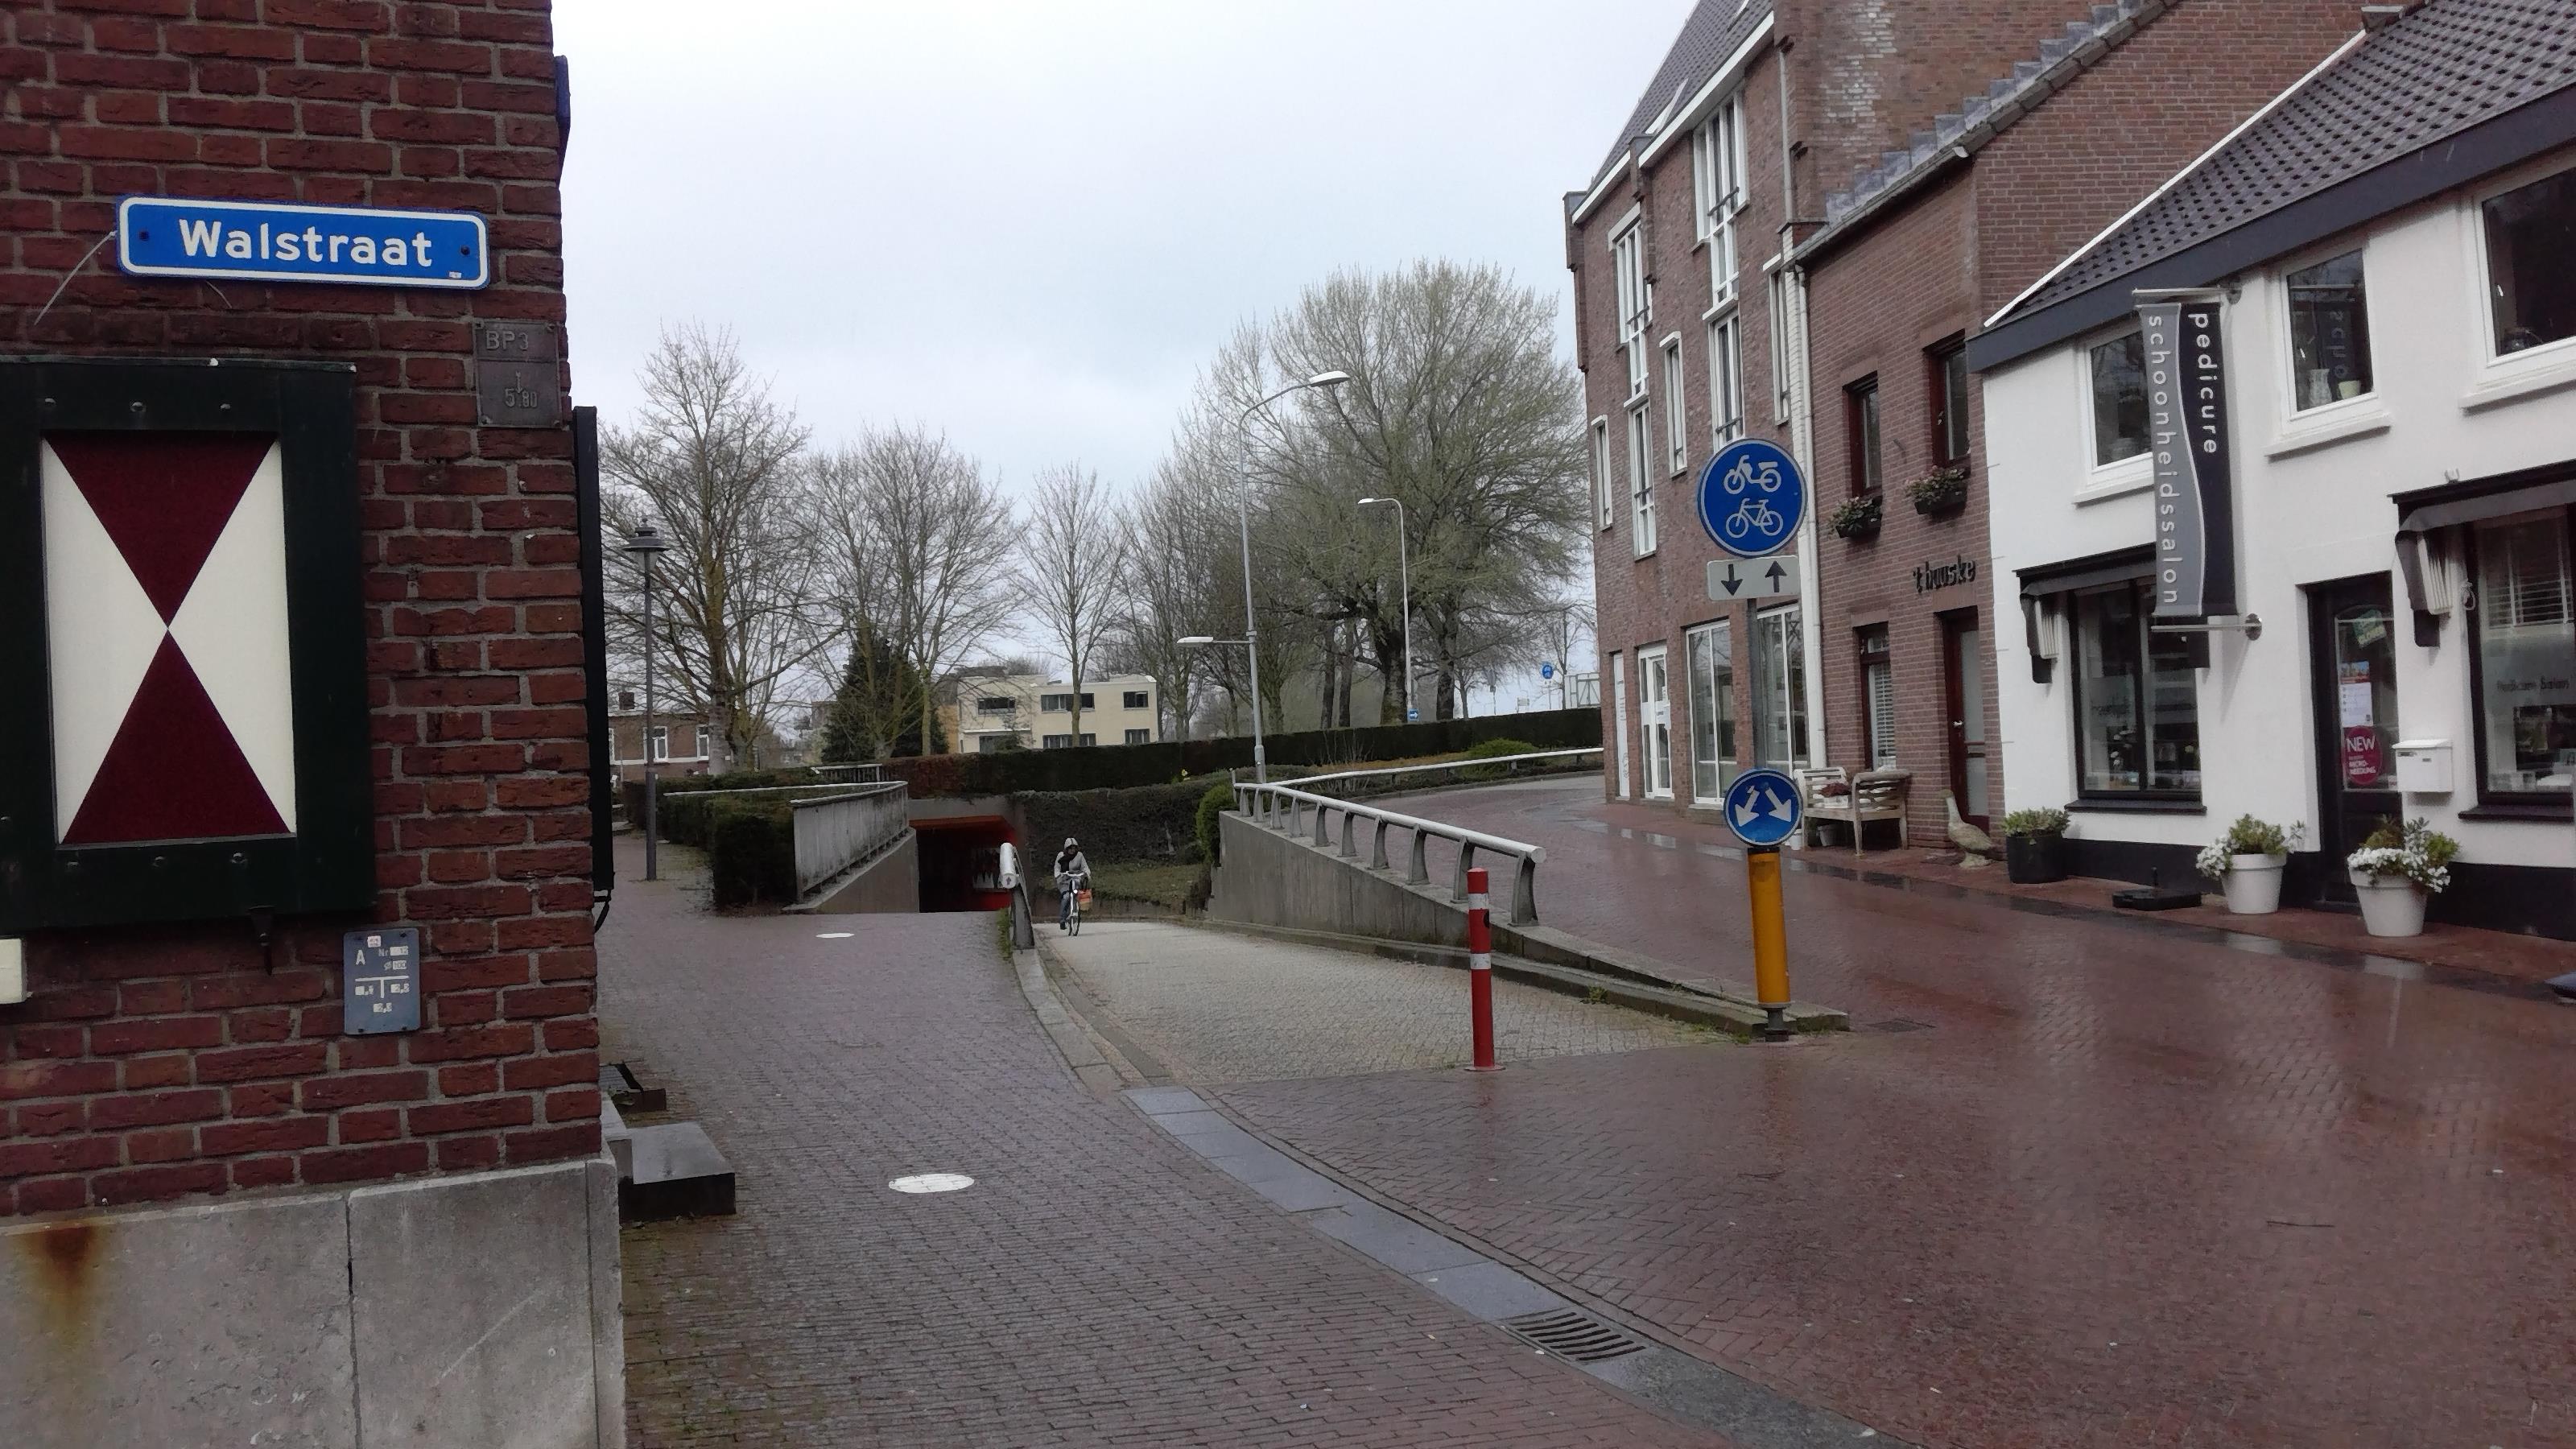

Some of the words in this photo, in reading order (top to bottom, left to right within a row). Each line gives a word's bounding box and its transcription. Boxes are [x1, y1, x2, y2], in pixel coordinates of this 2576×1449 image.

[179, 218, 432, 267] Walstraat
[2187, 313, 2218, 454] pedicure
[2149, 315, 2183, 604] schoonheidssalon
[2346, 735, 2376, 753] NEW
[355, 949, 365, 965] A
